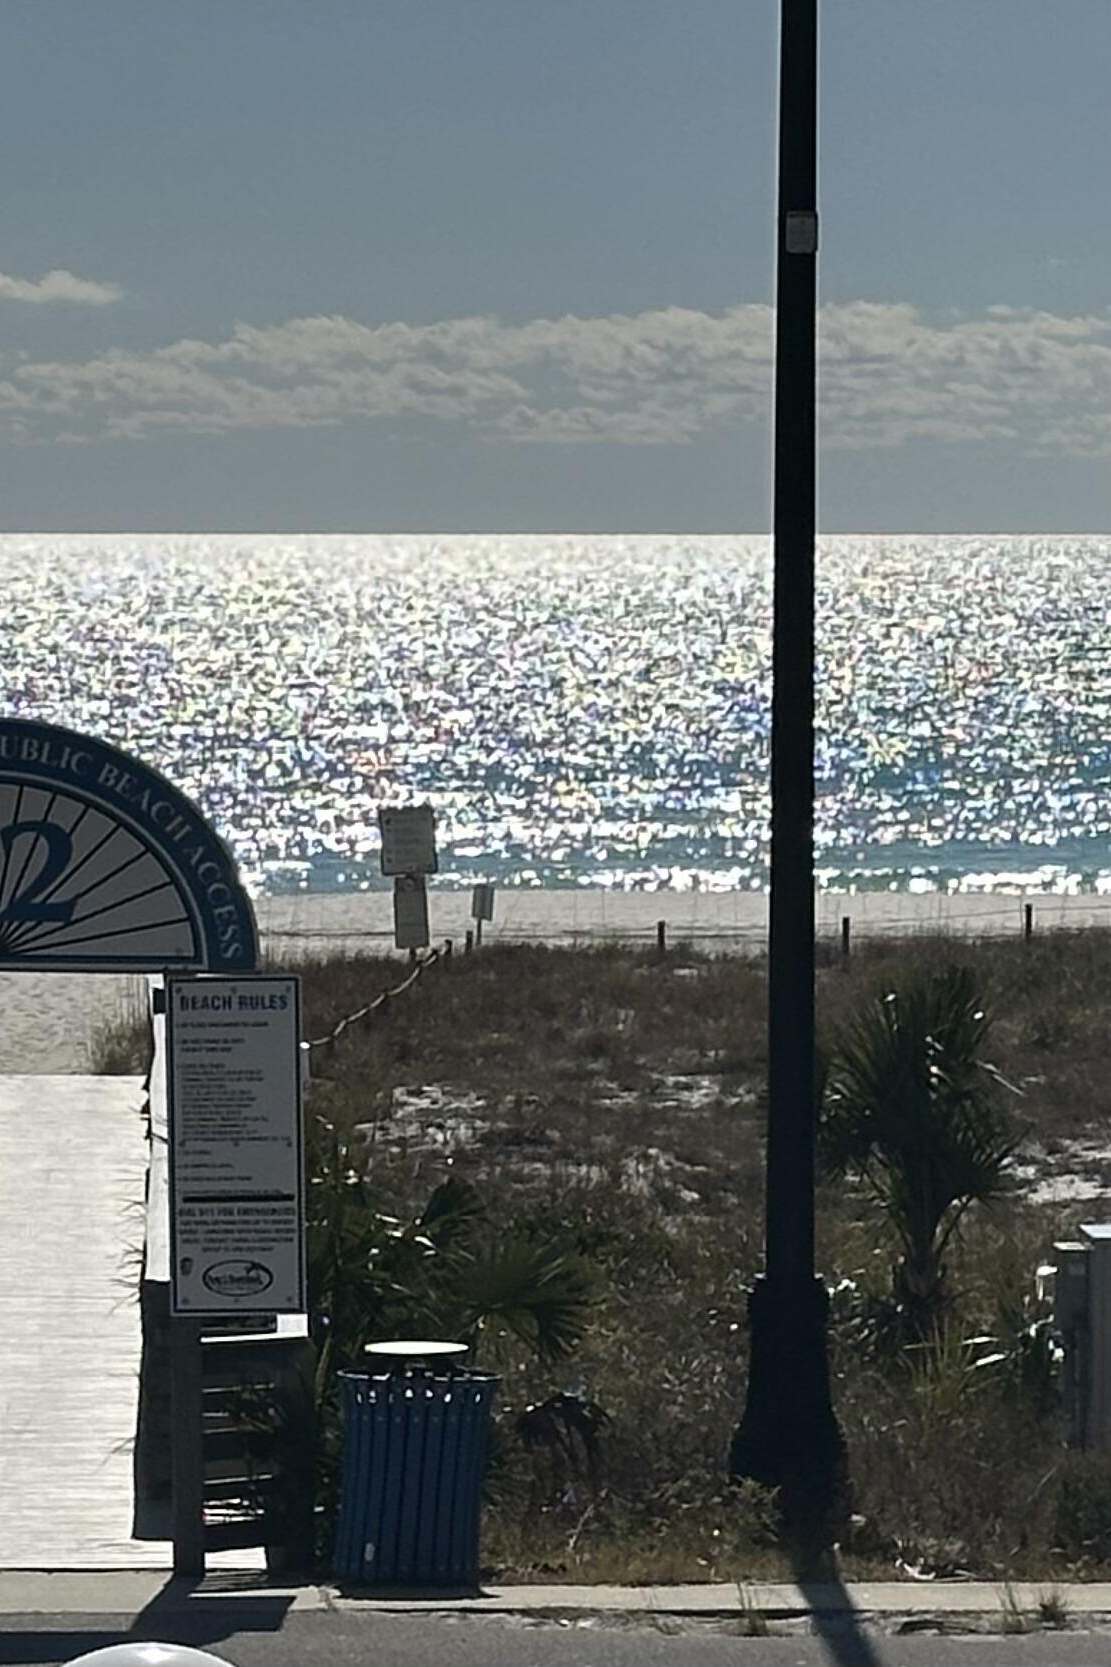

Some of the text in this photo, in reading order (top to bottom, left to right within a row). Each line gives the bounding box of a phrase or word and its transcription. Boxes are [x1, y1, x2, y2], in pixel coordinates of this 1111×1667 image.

[97, 762, 193, 842] BEACH
[183, 845, 243, 958] ACCESS
[180, 994, 288, 1011] BEACH RULES
